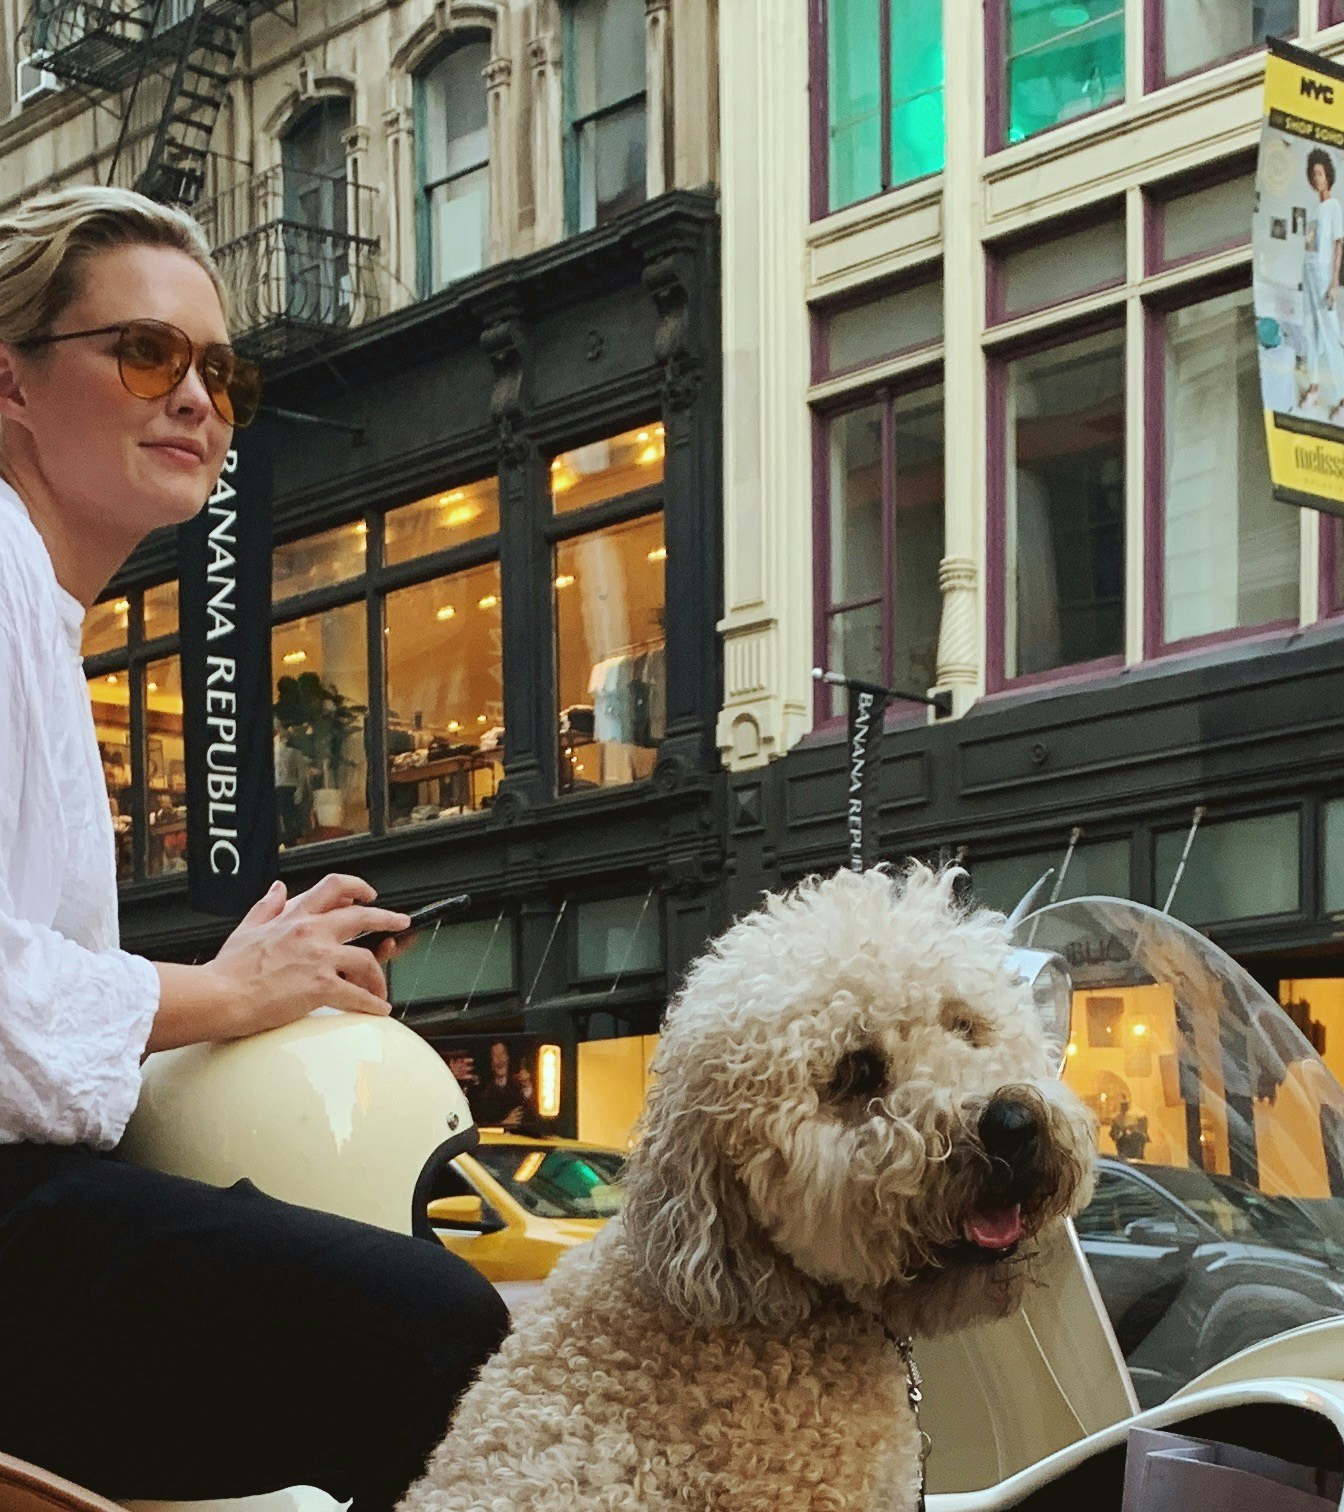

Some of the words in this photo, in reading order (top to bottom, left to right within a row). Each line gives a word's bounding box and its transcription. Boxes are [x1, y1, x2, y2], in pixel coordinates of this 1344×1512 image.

[1300, 75, 1334, 105] NYC
[206, 655, 241, 876] REPUBLIC
[849, 692, 874, 793] BANANA
[848, 798, 863, 872] REPUB
